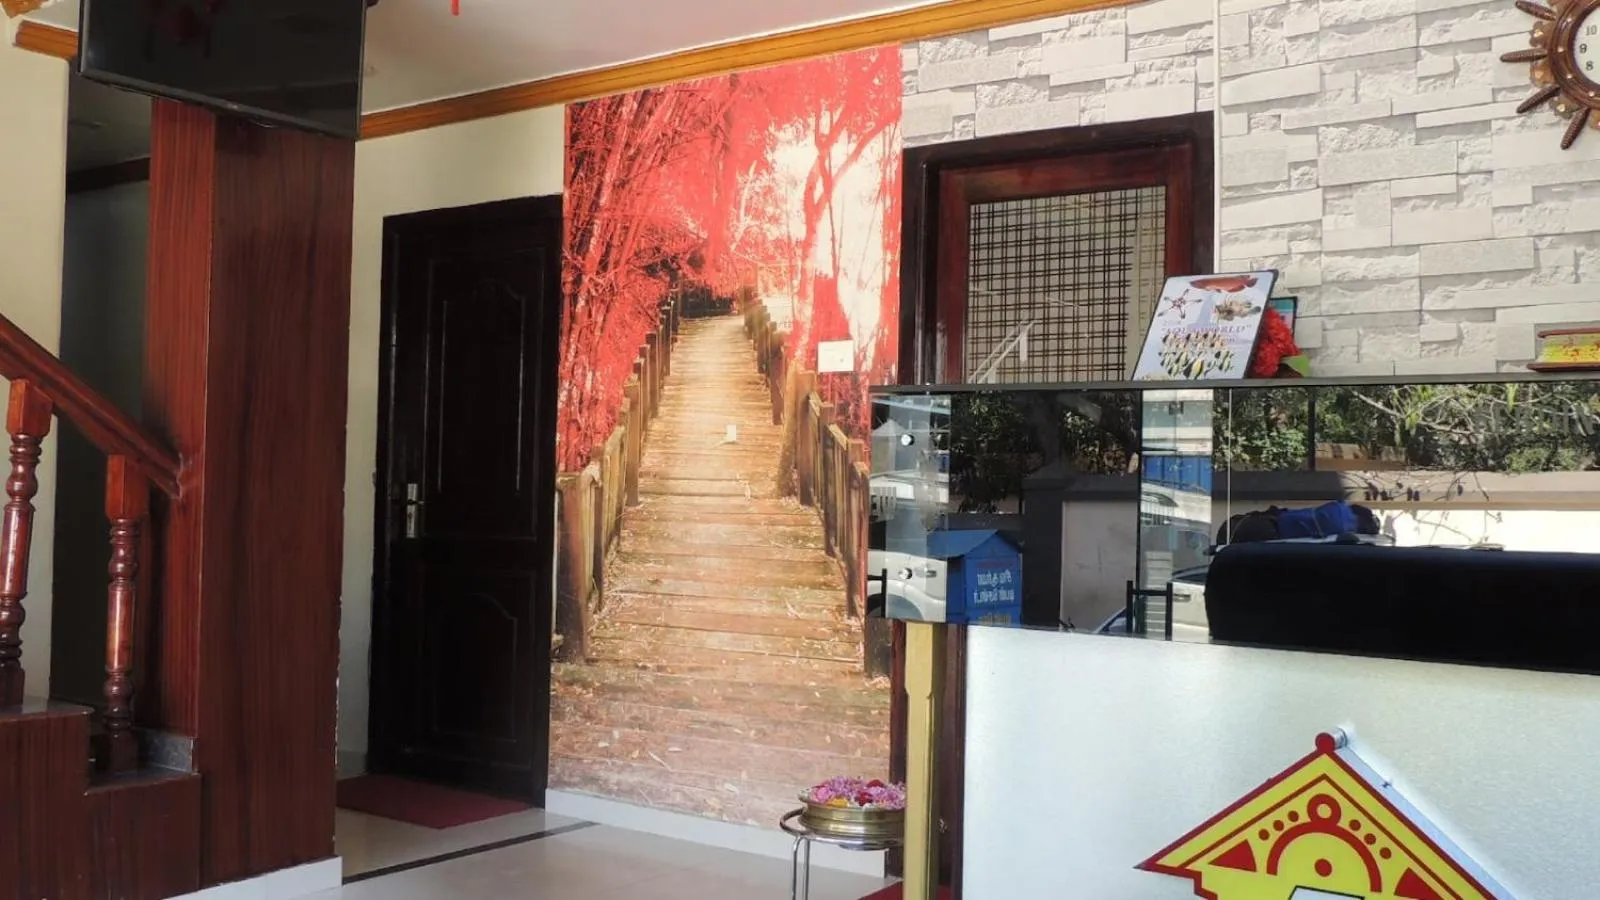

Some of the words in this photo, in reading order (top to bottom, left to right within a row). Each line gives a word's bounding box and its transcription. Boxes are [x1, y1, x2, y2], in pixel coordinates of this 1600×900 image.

[1586, 25, 1597, 36] 10
[1580, 43, 1587, 54] 9
[1585, 60, 1594, 71] 8
